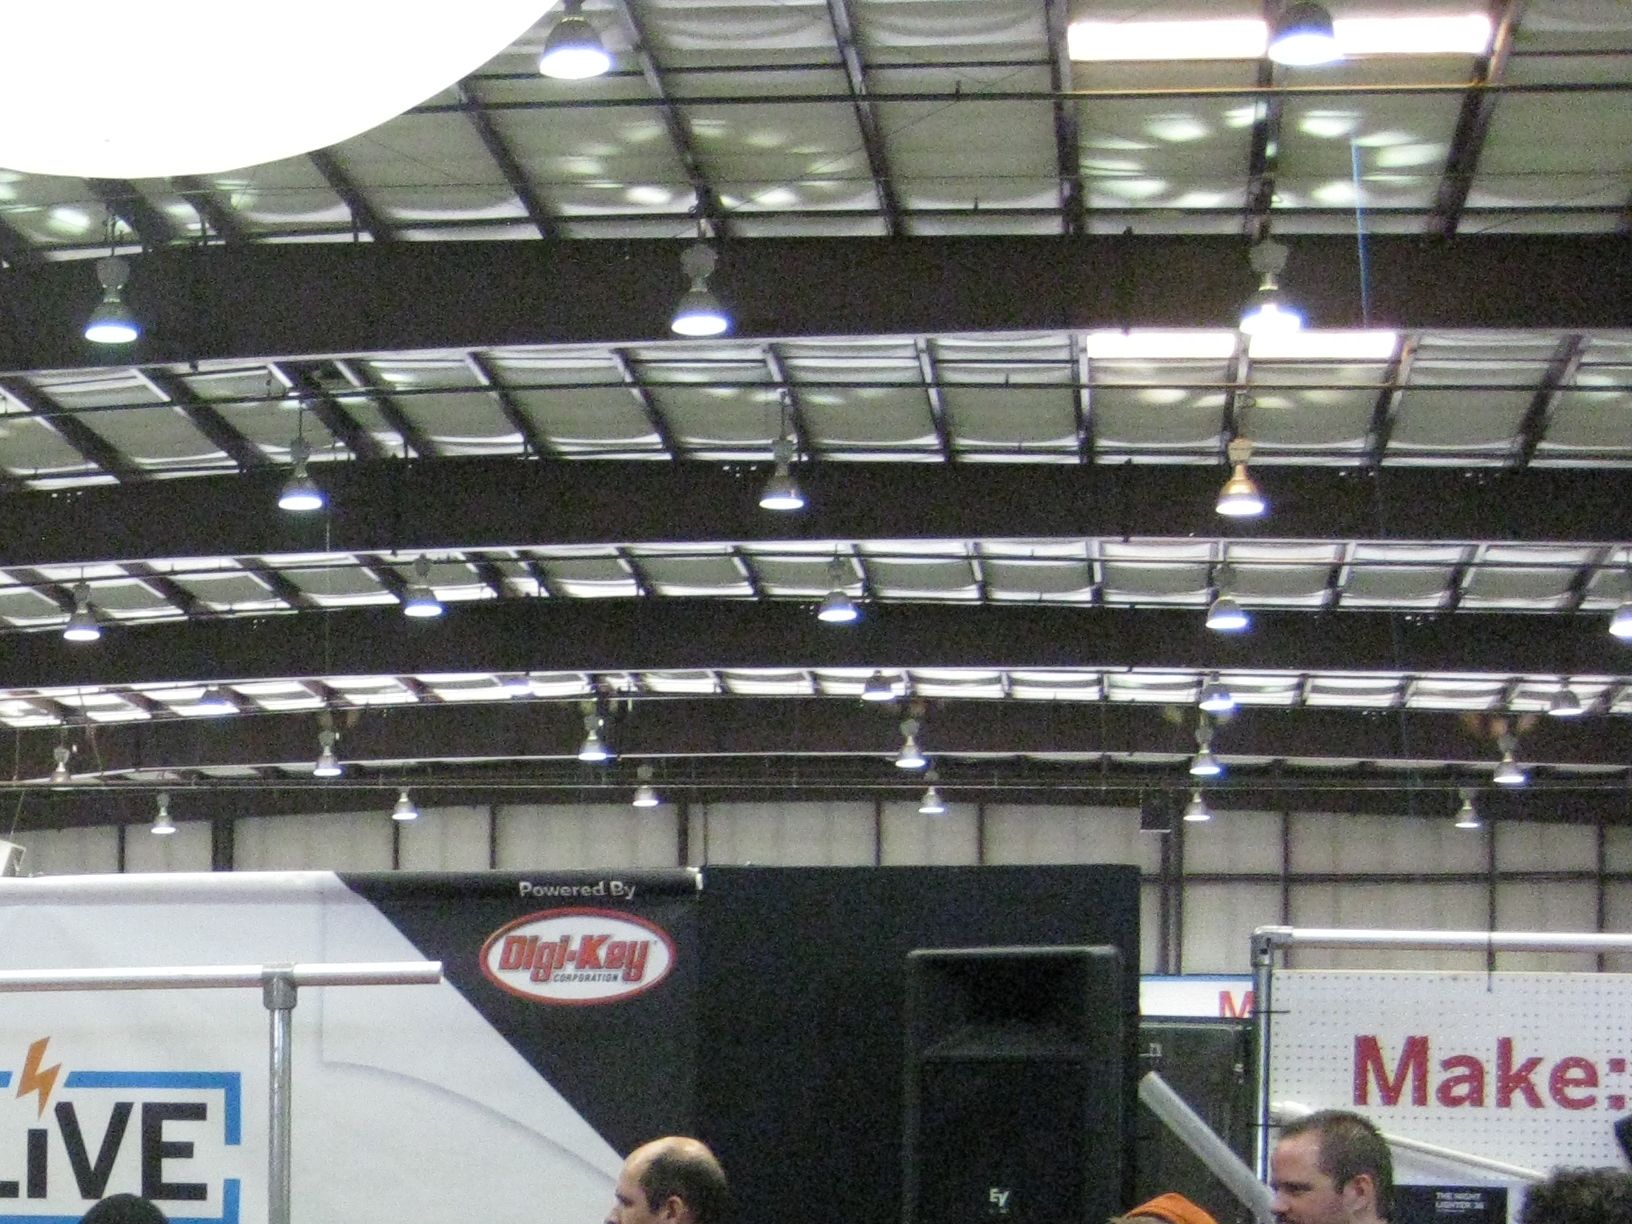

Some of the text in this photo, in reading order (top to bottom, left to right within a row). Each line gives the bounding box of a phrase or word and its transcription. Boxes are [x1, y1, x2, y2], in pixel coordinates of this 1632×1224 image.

[519, 881, 636, 900] Powered By
[553, 973, 618, 982] CORPORATION
[1353, 1035, 1626, 1110] Make:
